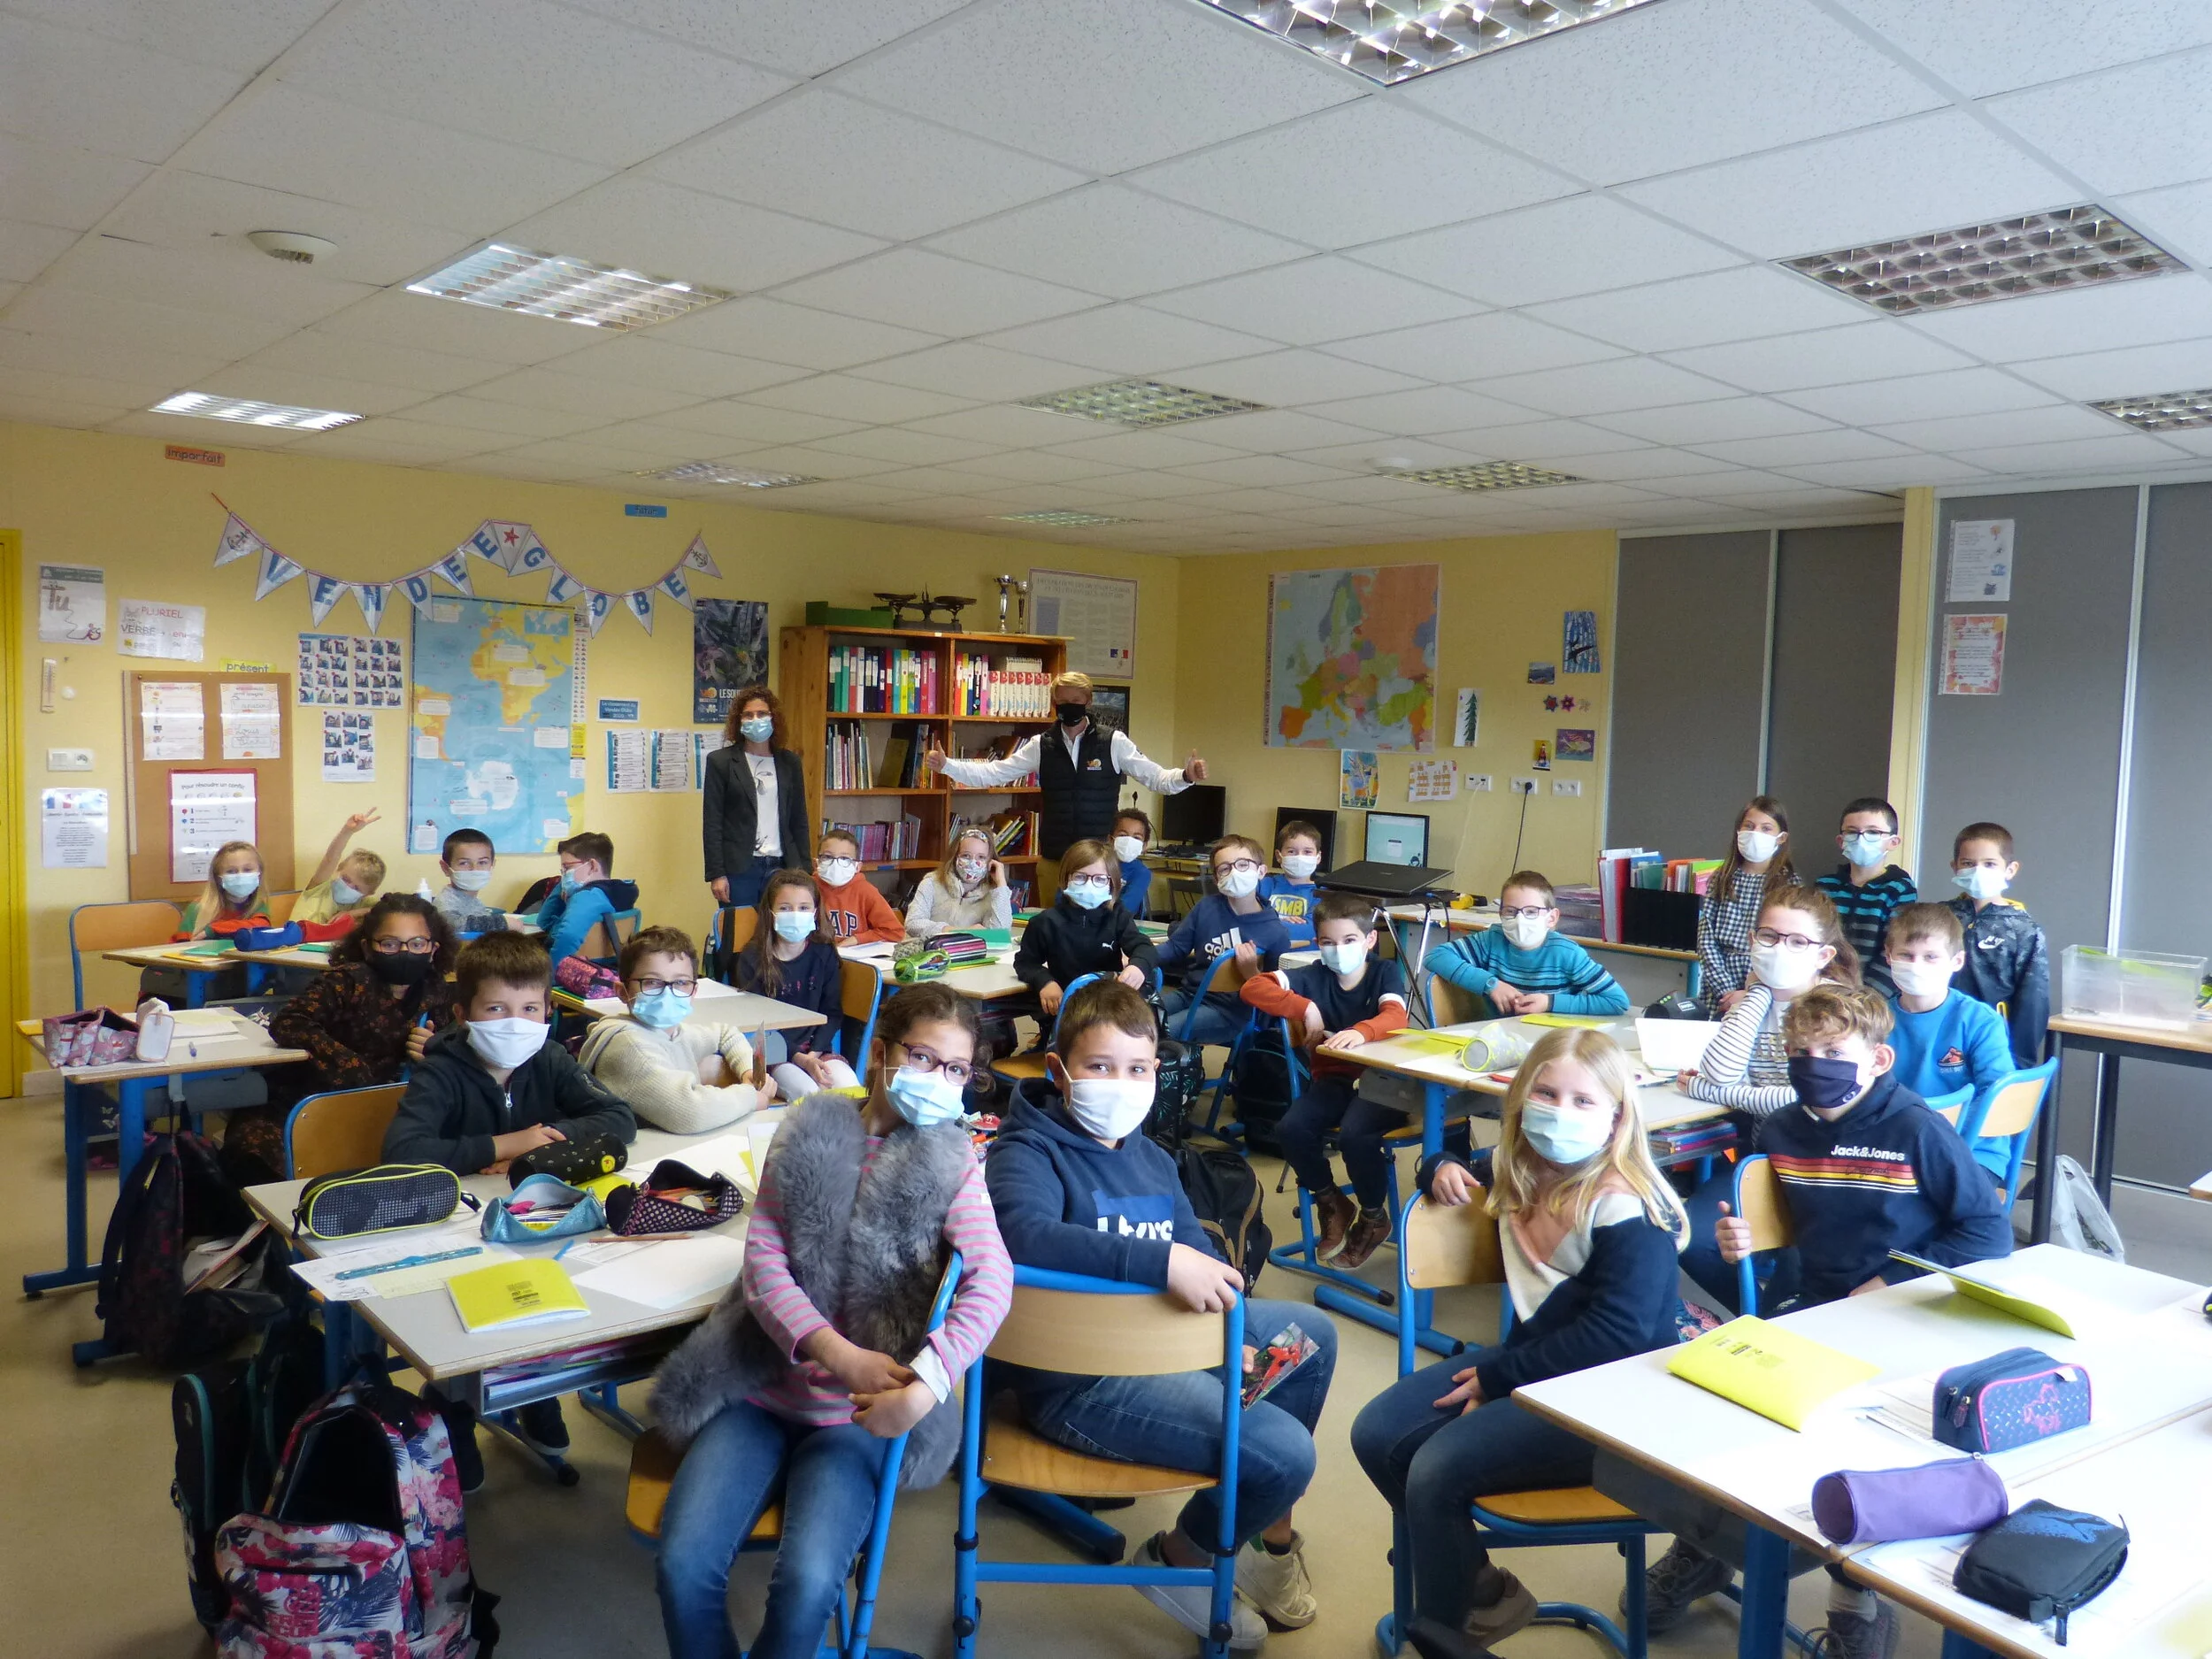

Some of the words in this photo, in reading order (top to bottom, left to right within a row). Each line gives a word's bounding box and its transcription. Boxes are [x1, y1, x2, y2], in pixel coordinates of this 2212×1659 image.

[524, 547, 687, 617] GLOBE
[140, 604, 184, 619] PLURIEL
[120, 623, 157, 636] VERBE
[226, 662, 270, 673] présent
[1274, 898, 1304, 917] SMB
[829, 910, 857, 938] AP
[1831, 1144, 1905, 1162] Jack&Jones
